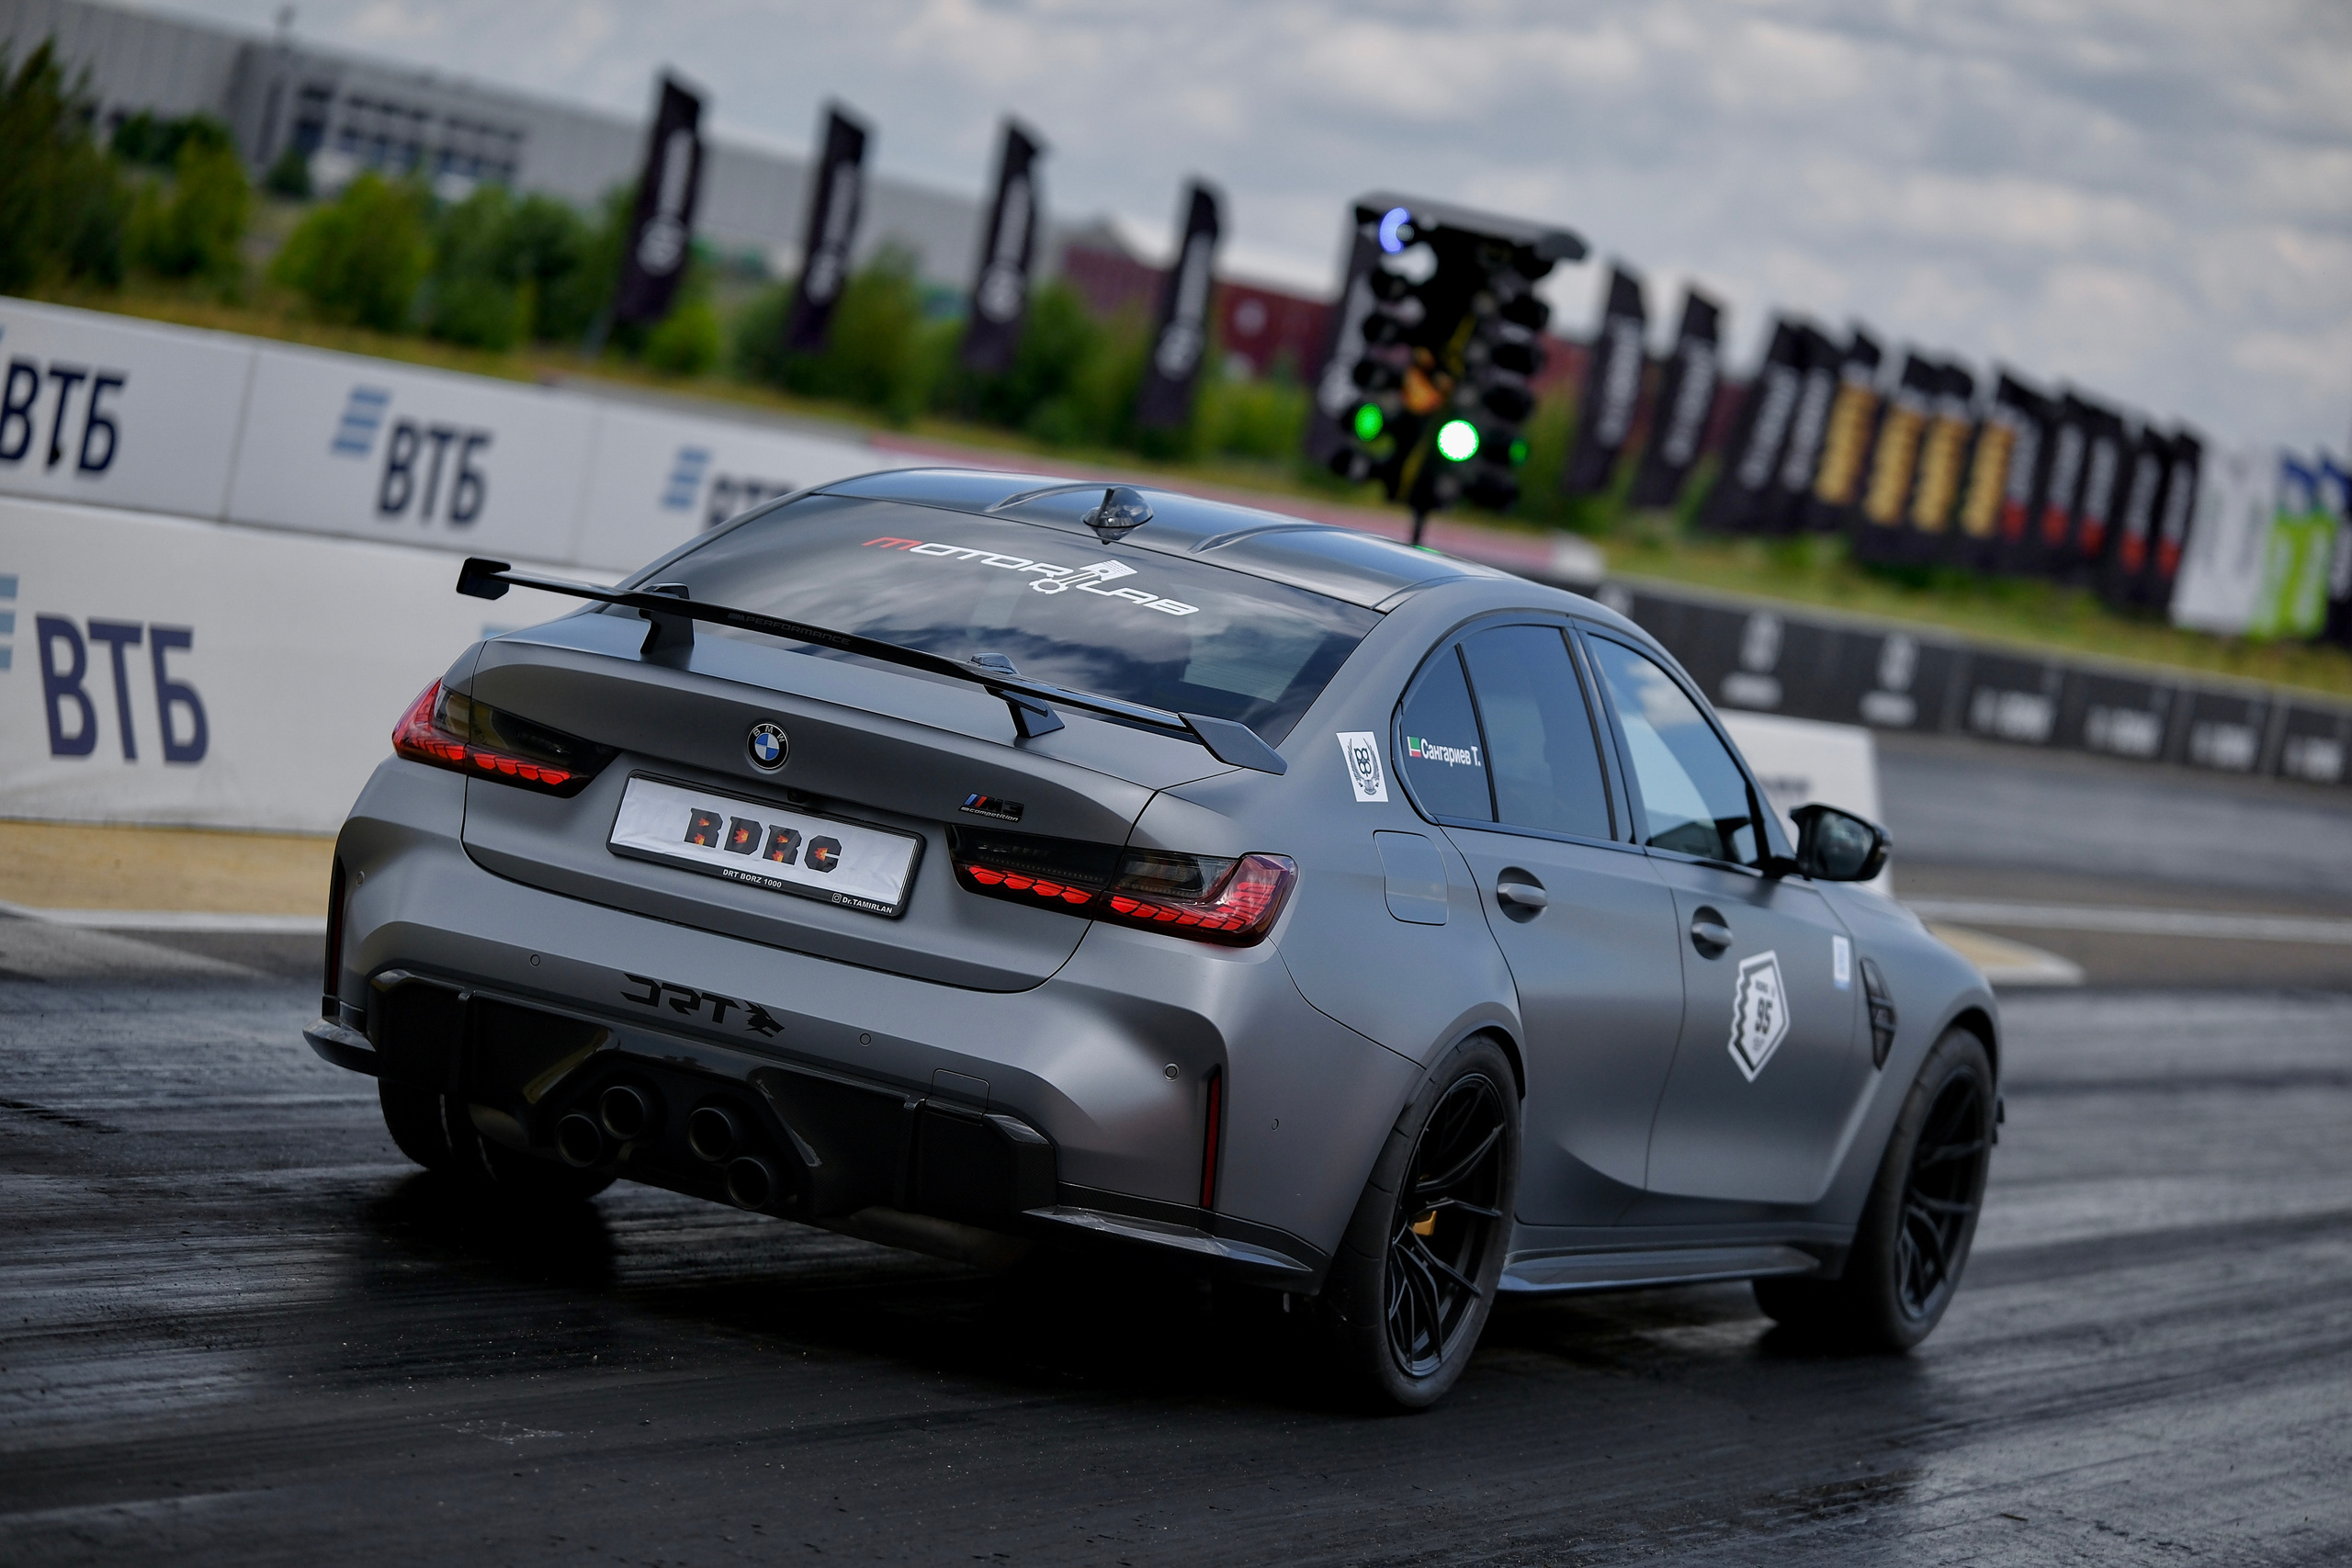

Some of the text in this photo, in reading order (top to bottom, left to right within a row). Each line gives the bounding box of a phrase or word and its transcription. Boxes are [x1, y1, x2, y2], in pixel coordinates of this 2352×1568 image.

[0, 358, 126, 473] ВТБ
[378, 421, 495, 527] ВТБ
[1076, 581, 1200, 615] LAB
[746, 616, 851, 645] PERFORMANCE
[35, 613, 209, 768] ВТБ
[753, 726, 785, 742] BMW
[1420, 738, 1481, 767] Сангариев Т.
[969, 807, 1019, 821] competition
[684, 807, 842, 873] RDRC
[722, 869, 782, 888] DRT BORZ 1000
[842, 897, 893, 914] Dr.TAMIRLAN
